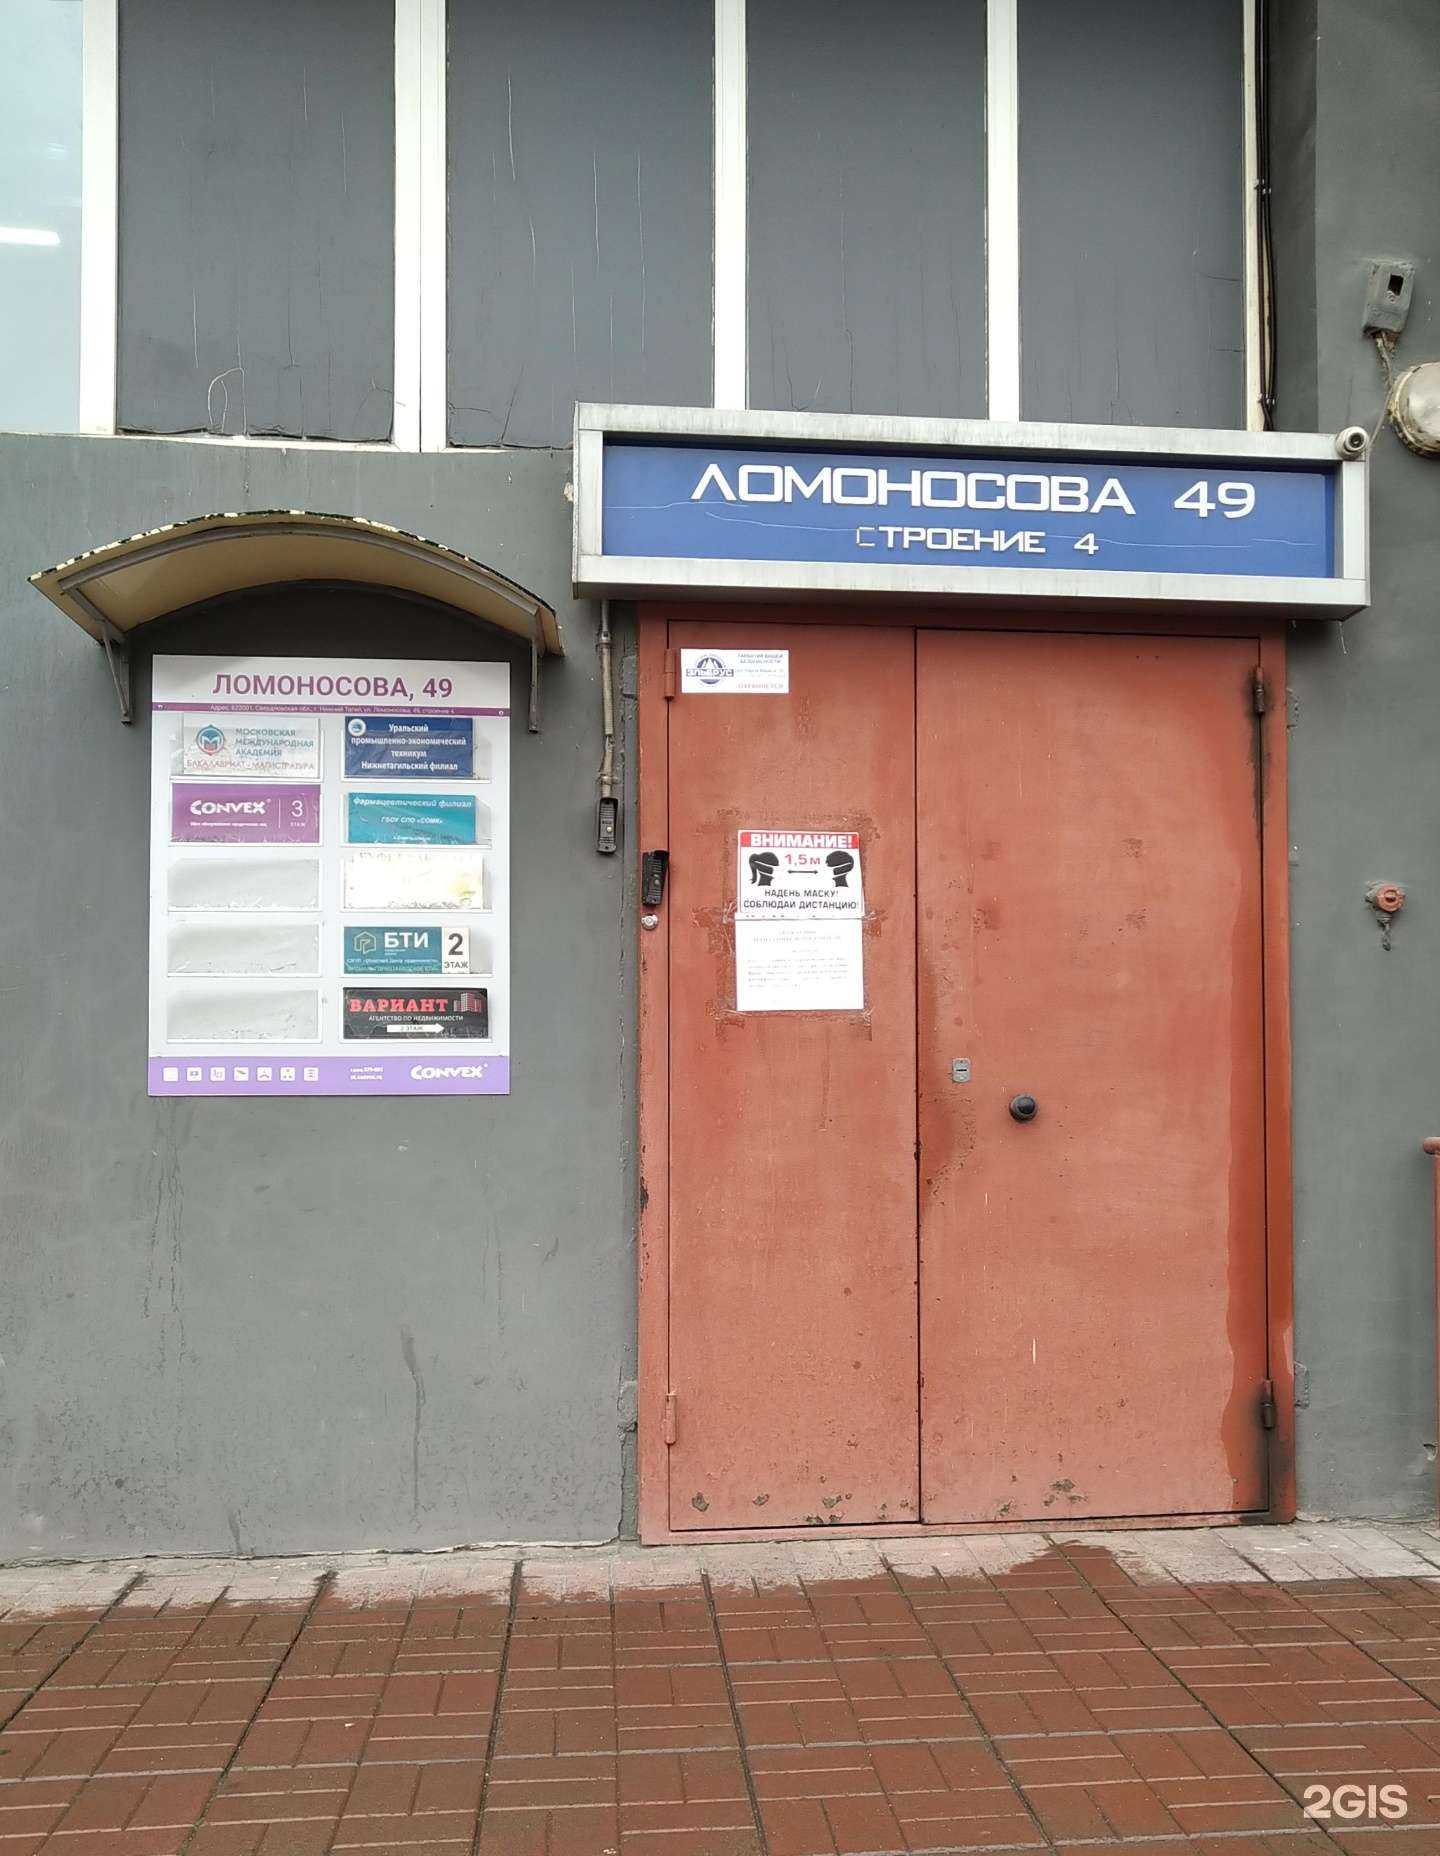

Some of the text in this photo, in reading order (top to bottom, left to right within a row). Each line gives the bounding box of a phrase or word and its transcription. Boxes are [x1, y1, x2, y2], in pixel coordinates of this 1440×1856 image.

[690, 463, 1256, 518] ЛОМОНОСОВА 49
[856, 525, 1099, 555] СТРОЕНИЕ 4
[212, 673, 453, 702] ЛОМОНОСОВА, 49
[235, 728, 296, 737] МОСКОВСКАЯ
[388, 723, 429, 733] Уральский
[235, 738, 314, 748] МЕЖДУНАРОДНАЯ
[351, 736, 467, 746] промышленно-экономический
[235, 749, 282, 757] АКАДЕМИЯ
[391, 750, 427, 758] техникум
[361, 761, 458, 772] Нижнетагильский филиал
[353, 797, 472, 808] Фармацевтический филиал
[291, 800, 303, 817] 3
[750, 833, 853, 848] ВНИМАНИЕ!
[784, 854, 808, 867] 1,5
[764, 889, 839, 898] НАДЕНЬ МАСКУ!
[384, 932, 429, 949] БТИ
[448, 933, 463, 956] 2
[444, 961, 469, 969] ЭТАЖ
[350, 999, 448, 1012] ВАРИАНТ
